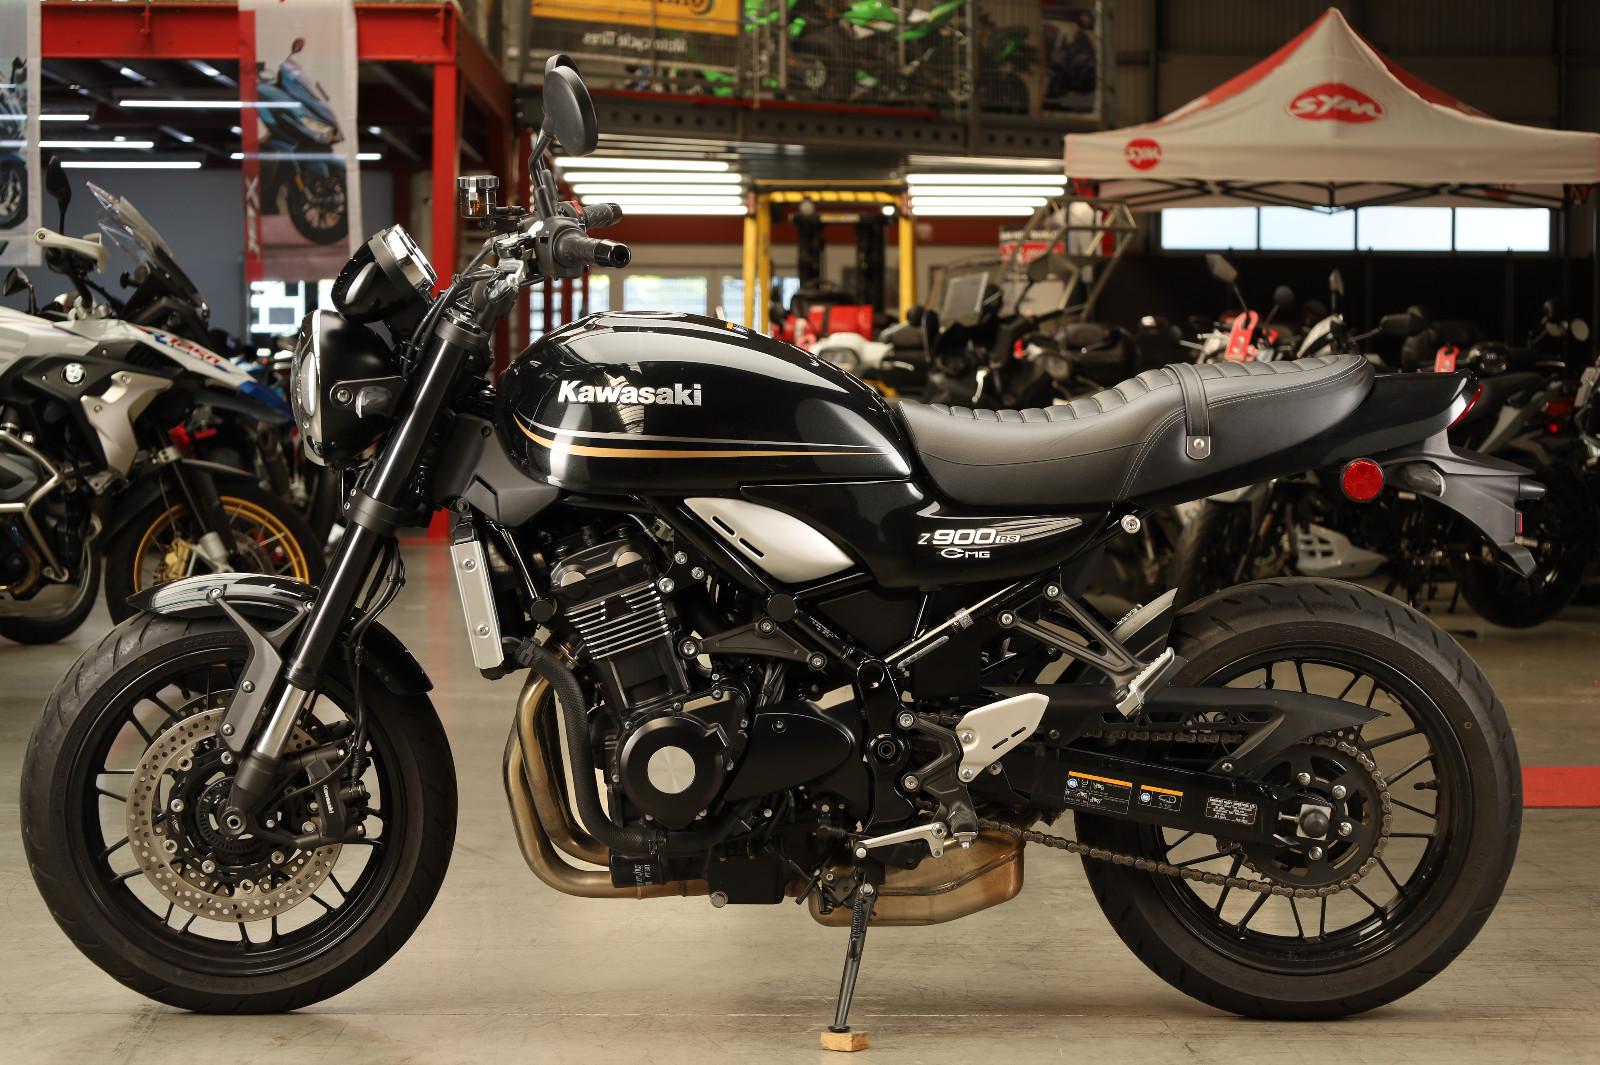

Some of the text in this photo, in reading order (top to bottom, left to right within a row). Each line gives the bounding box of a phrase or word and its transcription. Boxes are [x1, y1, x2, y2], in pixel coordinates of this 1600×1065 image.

[1290, 94, 1383, 118] SYM
[1124, 147, 1162, 165] SYM
[557, 380, 702, 406] Kawasaki
[940, 547, 991, 559] CMG
